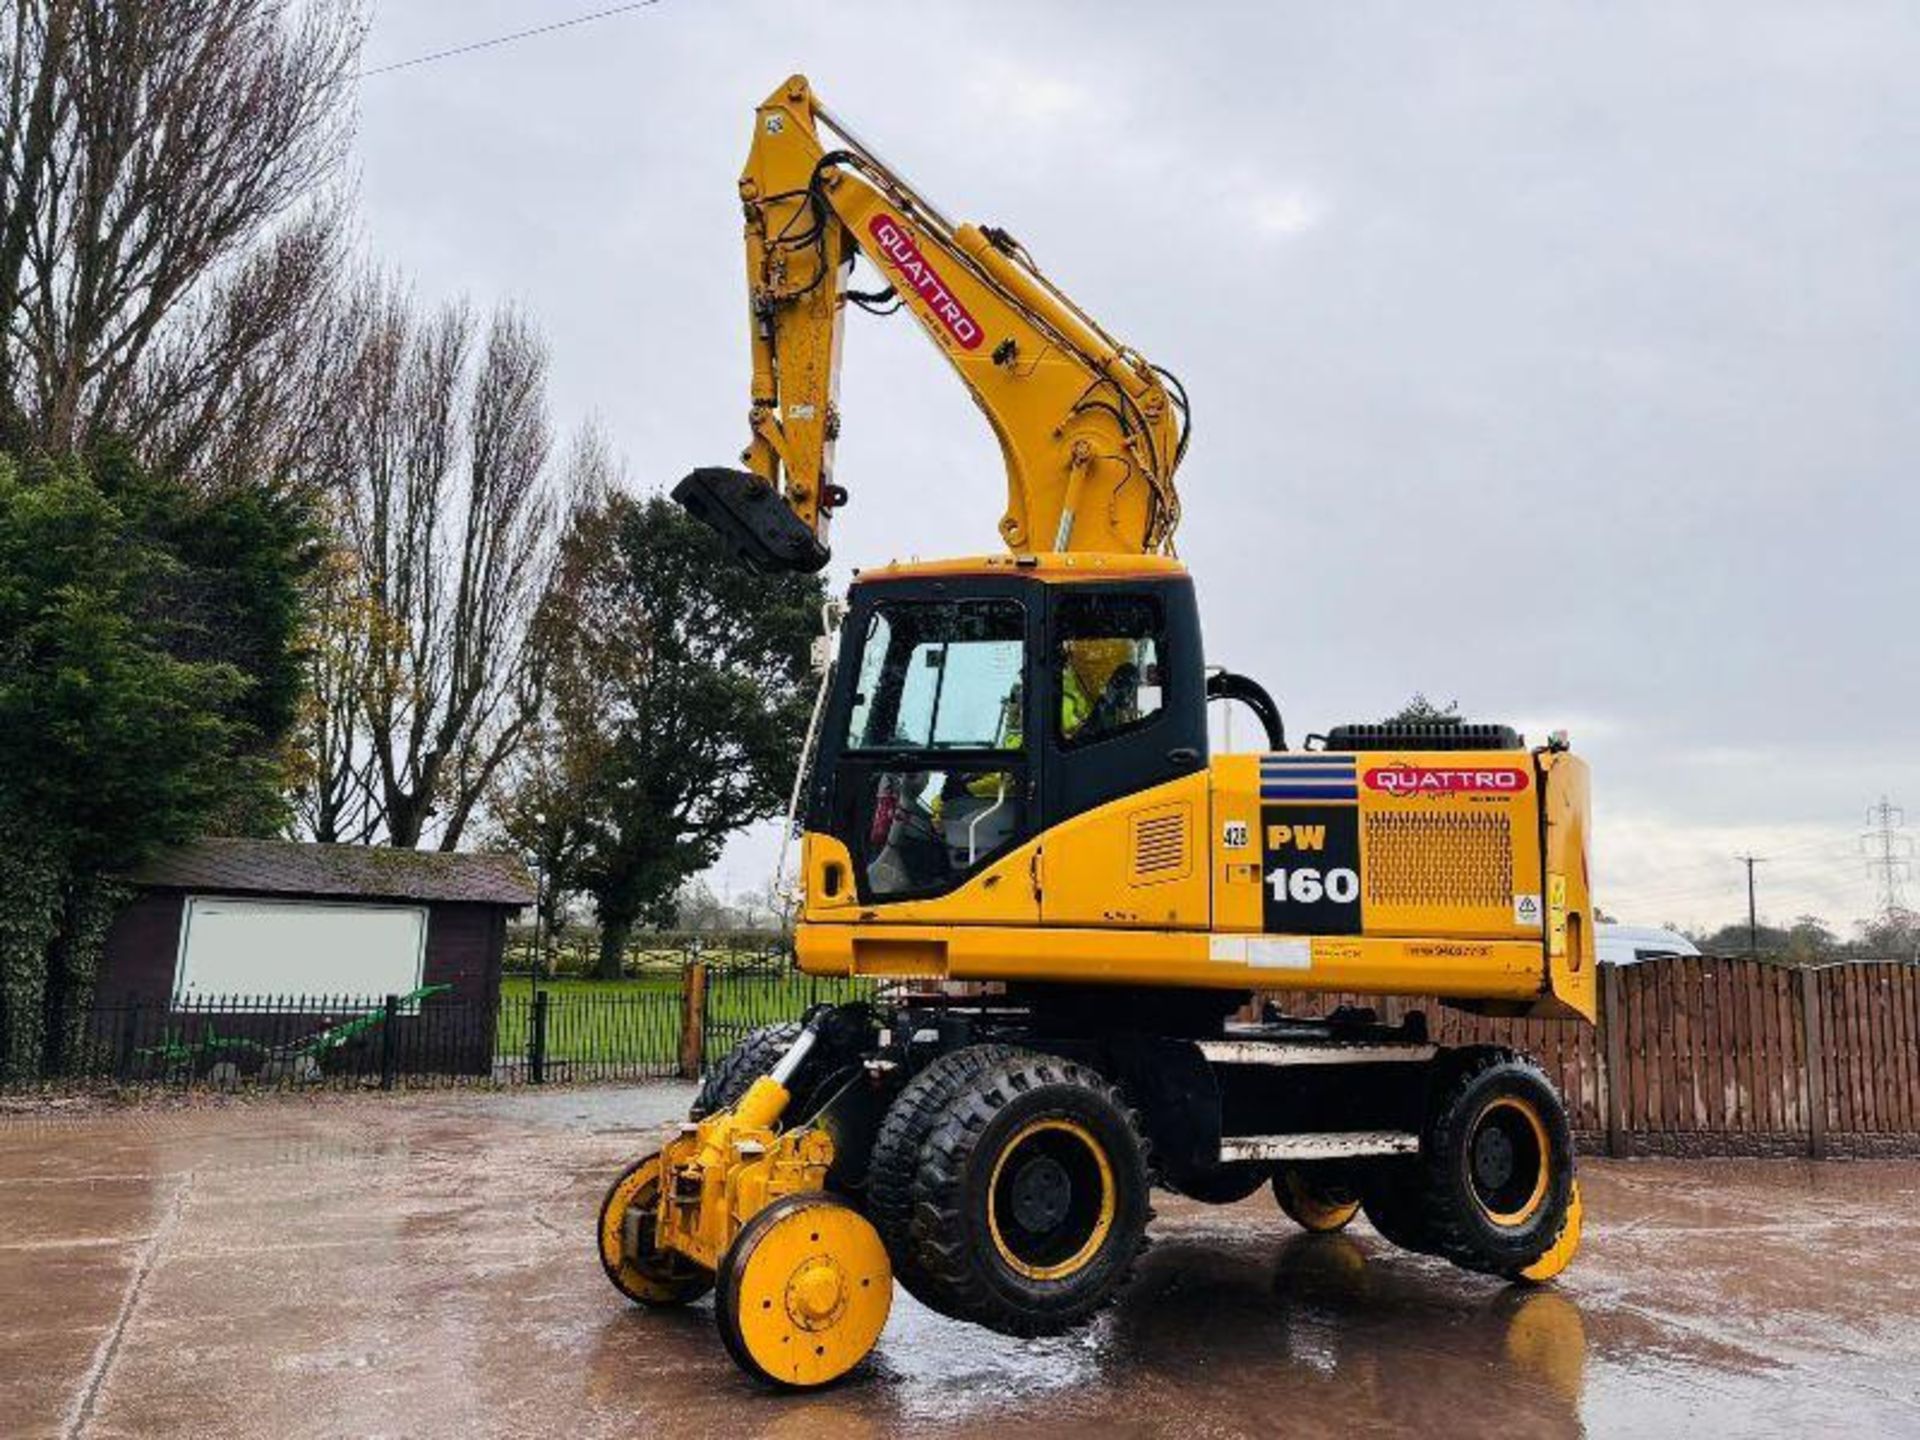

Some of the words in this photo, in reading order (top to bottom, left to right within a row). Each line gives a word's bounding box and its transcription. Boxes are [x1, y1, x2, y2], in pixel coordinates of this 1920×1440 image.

[877, 223, 977, 343] QUATTRO
[1376, 771, 1516, 789] QUATTRO
[1266, 824, 1326, 851] PW
[1264, 867, 1360, 904] 160
